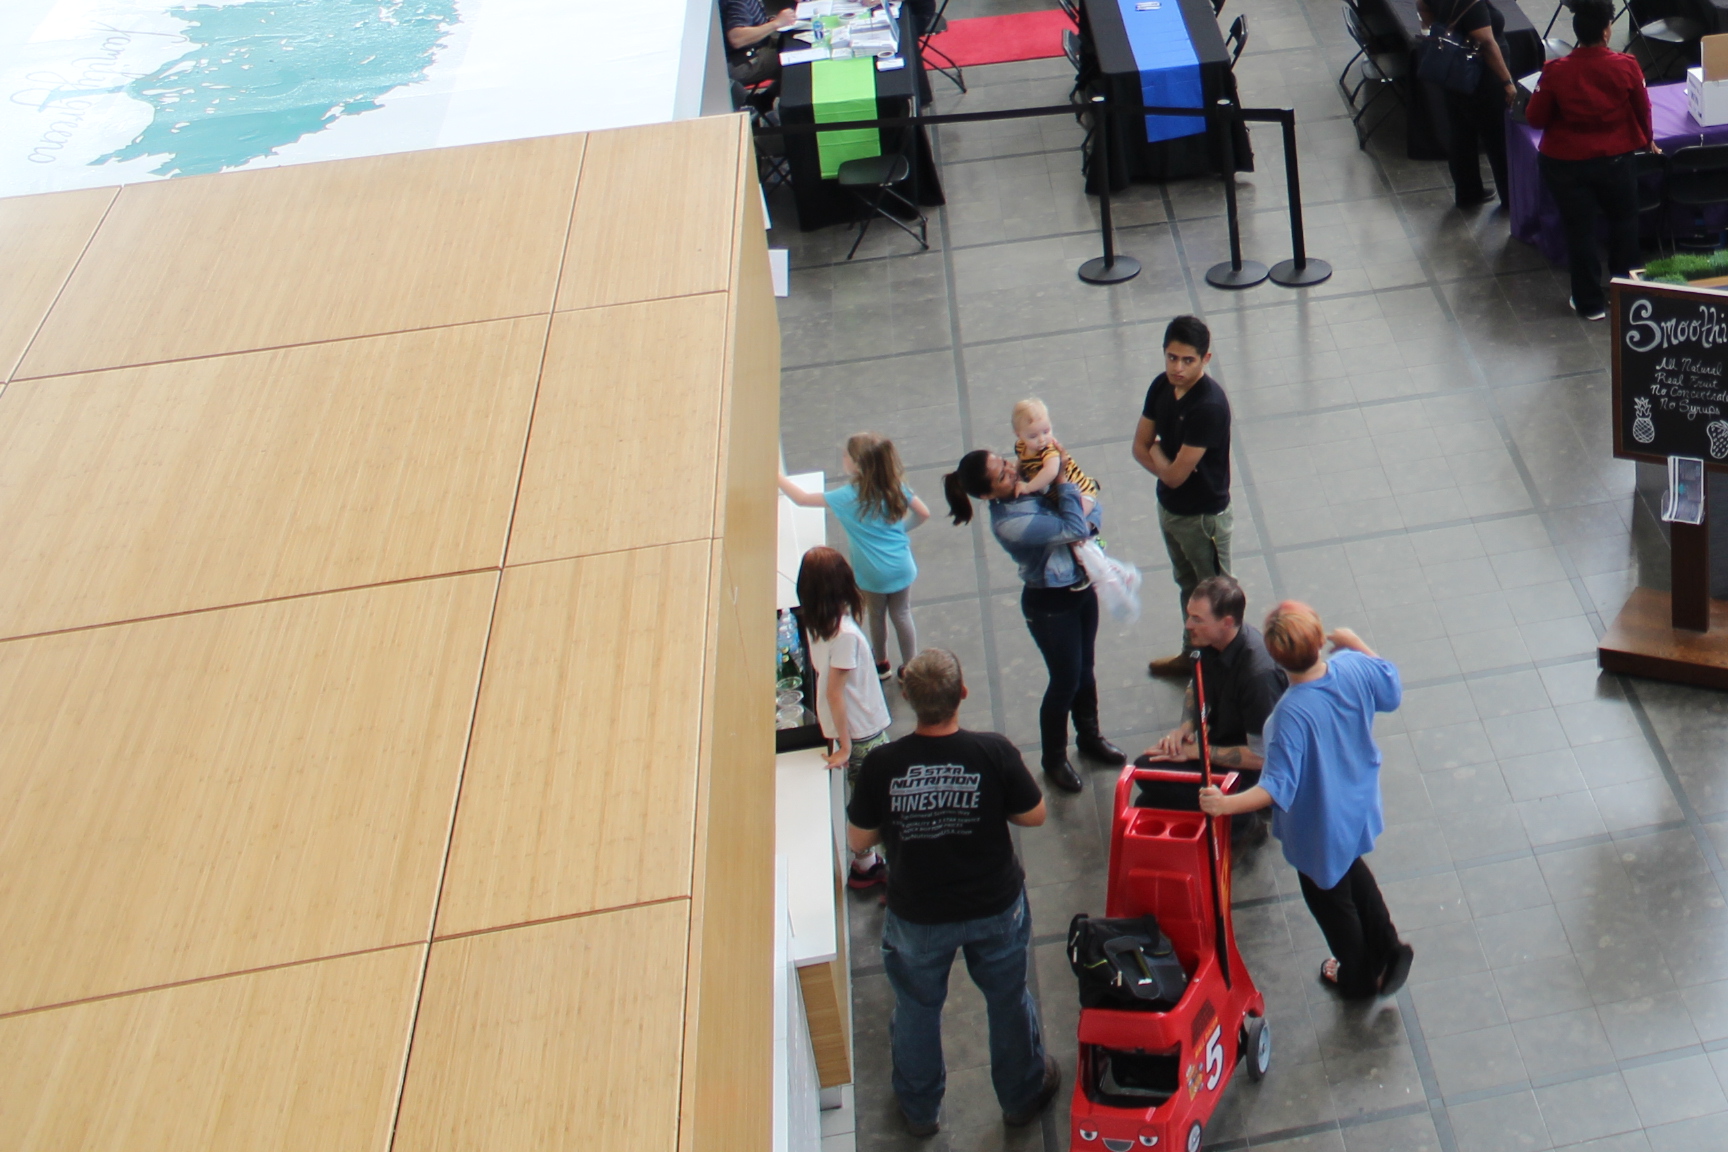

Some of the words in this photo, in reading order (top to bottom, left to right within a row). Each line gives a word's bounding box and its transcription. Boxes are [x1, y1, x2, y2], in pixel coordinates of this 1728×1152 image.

[1656, 357, 1677, 370] All
[1682, 358, 1722, 376] Natural
[1655, 372, 1683, 386] Real
[1690, 375, 1718, 389] Fruit
[1651, 385, 1667, 396] No
[1660, 398, 1676, 409] No
[1679, 400, 1720, 420] Syrups
[909, 767, 922, 778] 5
[924, 764, 963, 776] STAR
[892, 775, 979, 790] NUTRITION
[890, 791, 981, 813] HINESVILLE
[1206, 1024, 1224, 1091] 5
